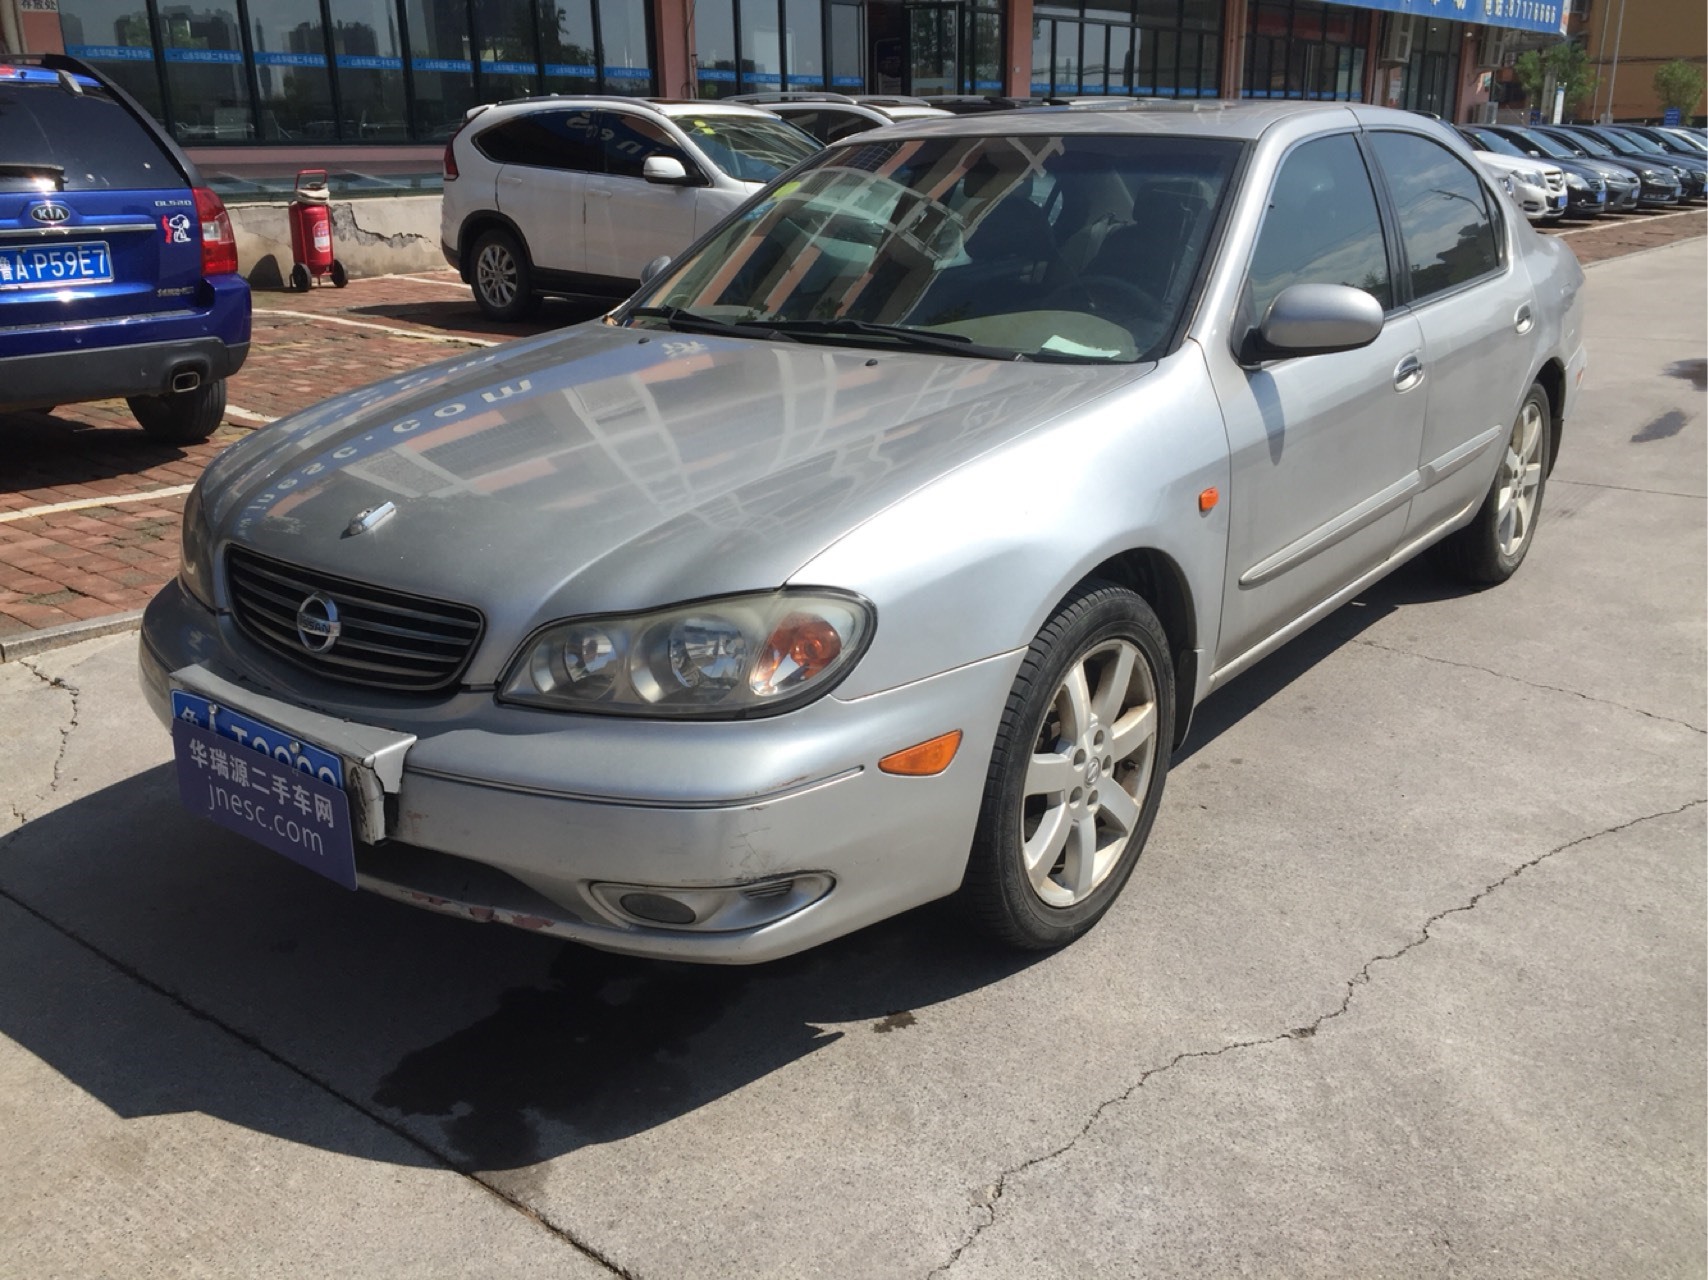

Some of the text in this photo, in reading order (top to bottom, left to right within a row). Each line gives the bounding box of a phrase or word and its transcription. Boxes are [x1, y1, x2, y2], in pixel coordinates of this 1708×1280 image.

[37, 208, 65, 220] KIA
[189, 738, 335, 828] 华瑞源二手车网
[208, 775, 324, 856] jnesc.com
